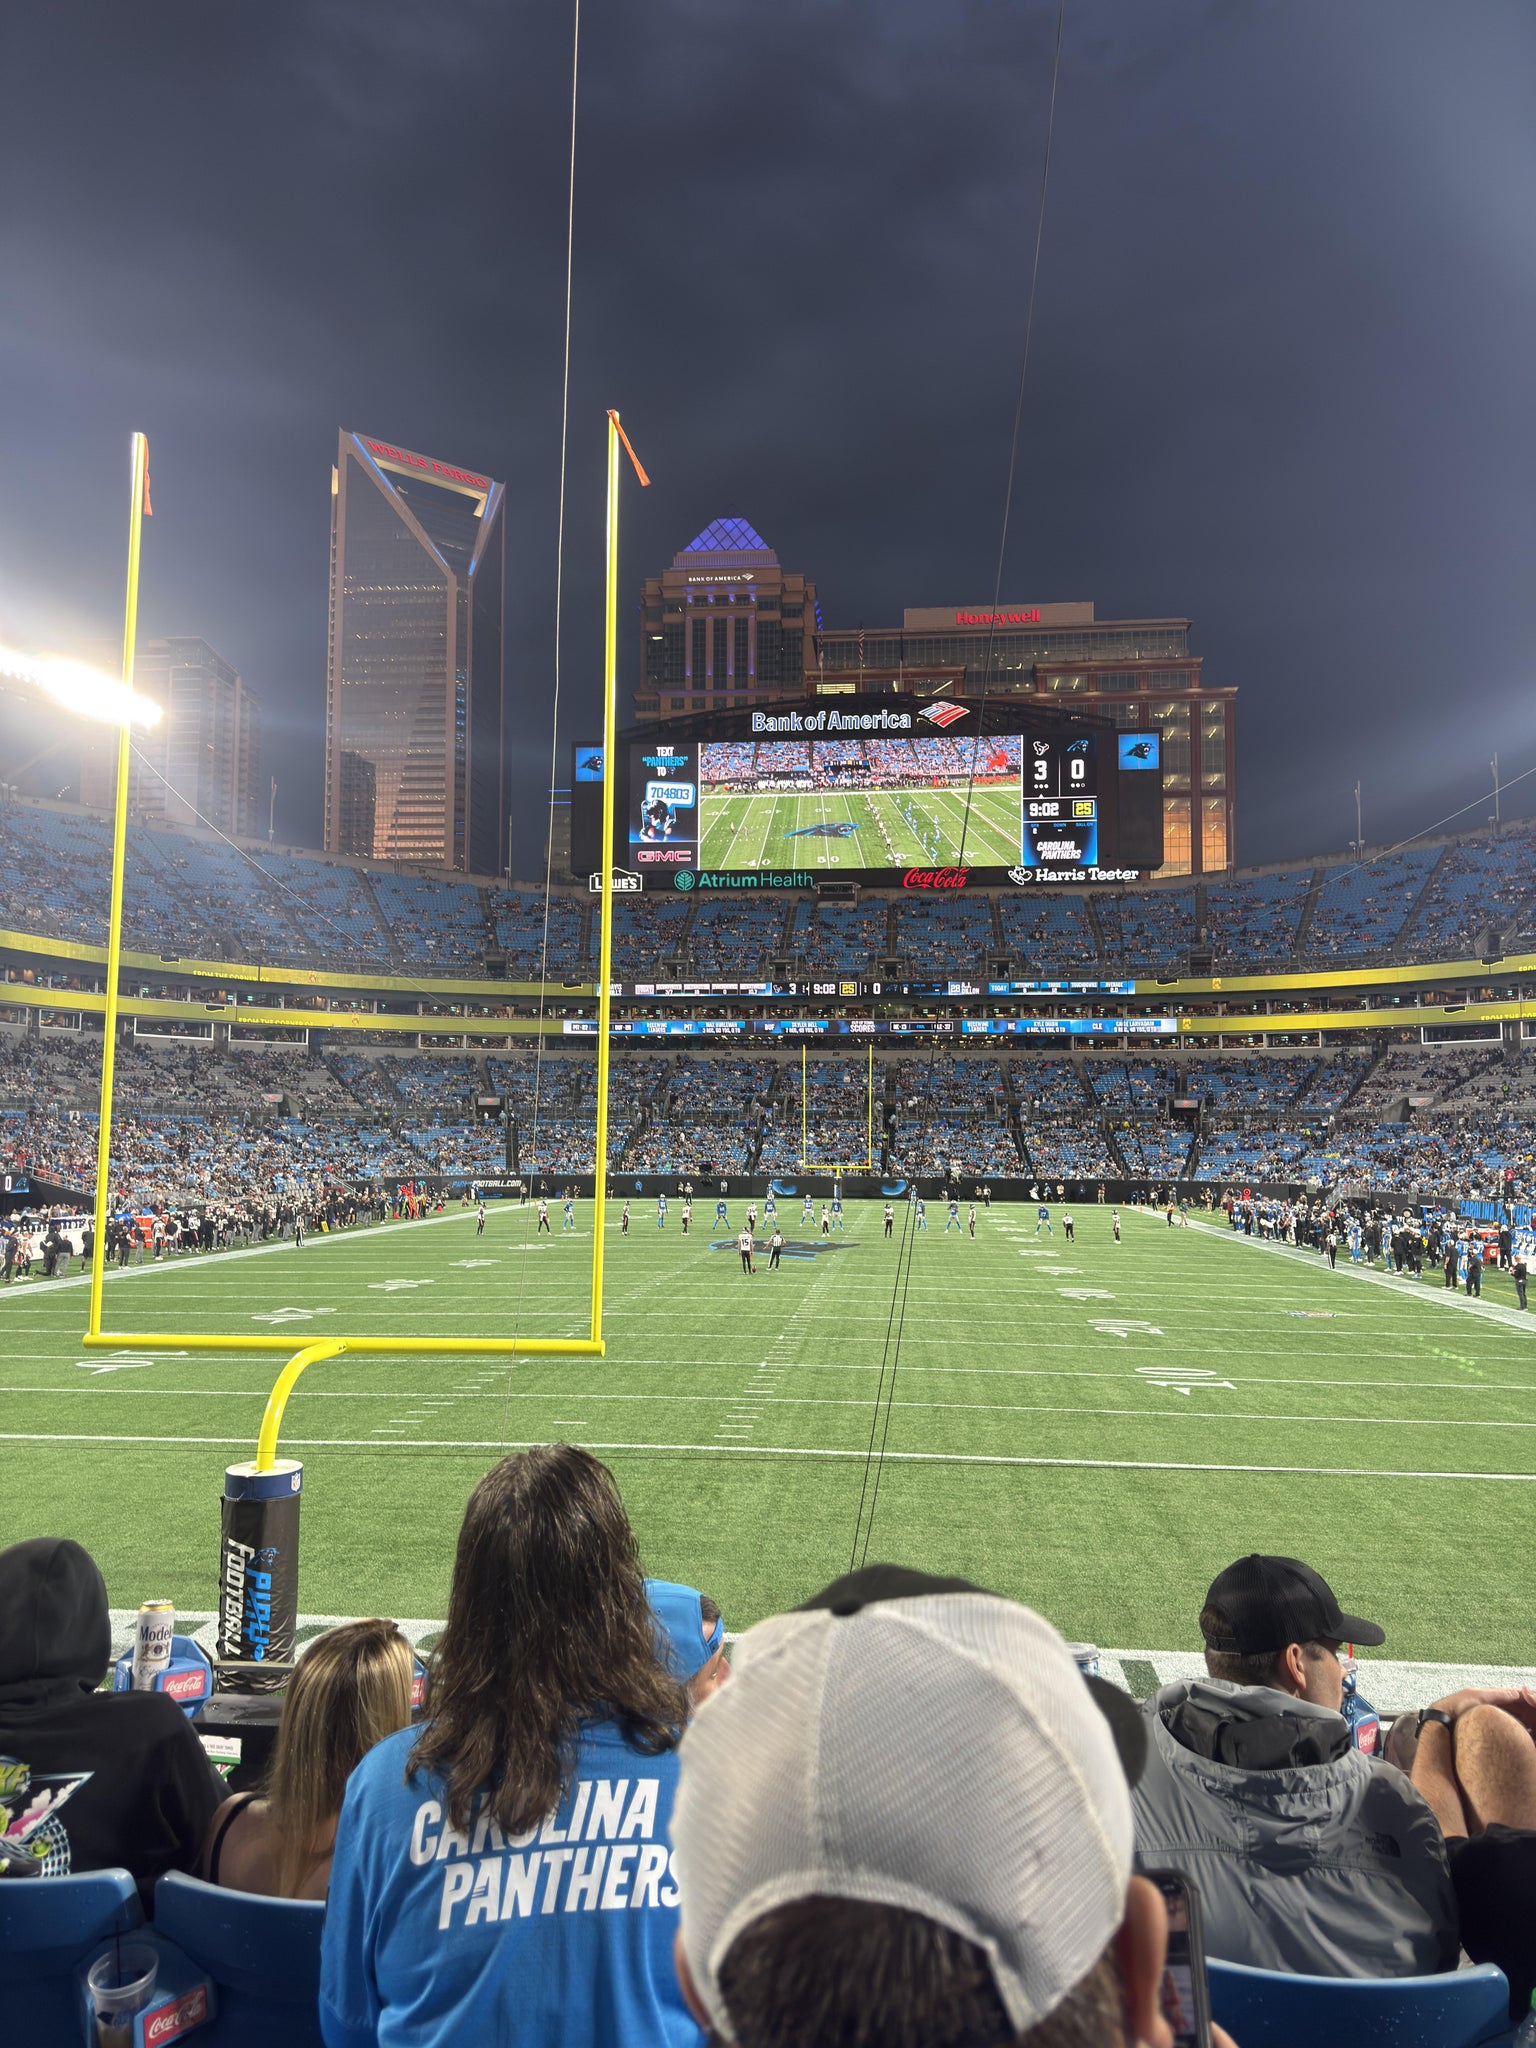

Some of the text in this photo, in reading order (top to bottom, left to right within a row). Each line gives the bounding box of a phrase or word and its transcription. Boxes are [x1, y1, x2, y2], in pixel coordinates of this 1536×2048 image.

[368, 441, 488, 488] WELLS FARGO
[956, 609, 1040, 627] Honeywell
[752, 709, 912, 732] Bank of America
[656, 746, 674, 757] TEXT
[656, 766, 667, 776] TO
[1034, 760, 1048, 781] 3
[1071, 759, 1085, 780] 0
[651, 787, 690, 800] 704803
[1029, 802, 1060, 817] 9:02
[1075, 802, 1092, 815] 25
[1036, 841, 1075, 852] CAROLINA
[637, 850, 692, 862] GMC
[1040, 849, 1082, 860] PANTHERS
[698, 870, 814, 887] Atrium Health
[903, 867, 970, 888] Coca-Cola
[1035, 867, 1139, 882] Harris Teeter
[594, 876, 637, 890] LWE'S
[788, 983, 797, 995] 3
[813, 983, 836, 995] 9:02
[841, 983, 855, 994] 25
[873, 982, 881, 995] 0
[950, 984, 960, 993] 28
[683, 1023, 693, 1031] PIT
[850, 1024, 876, 1033] SCORES
[1092, 1022, 1103, 1030] CLE
[4, 1175, 12, 1191] 0
[741, 1238, 749, 1247] 15
[1489, 1248, 1497, 1256] G
[225, 1537, 255, 1655] FOOTBALL
[140, 1624, 172, 1641] Model
[166, 1675, 202, 1692] Coca-Cola
[438, 1844, 683, 1930] PANTHERS
